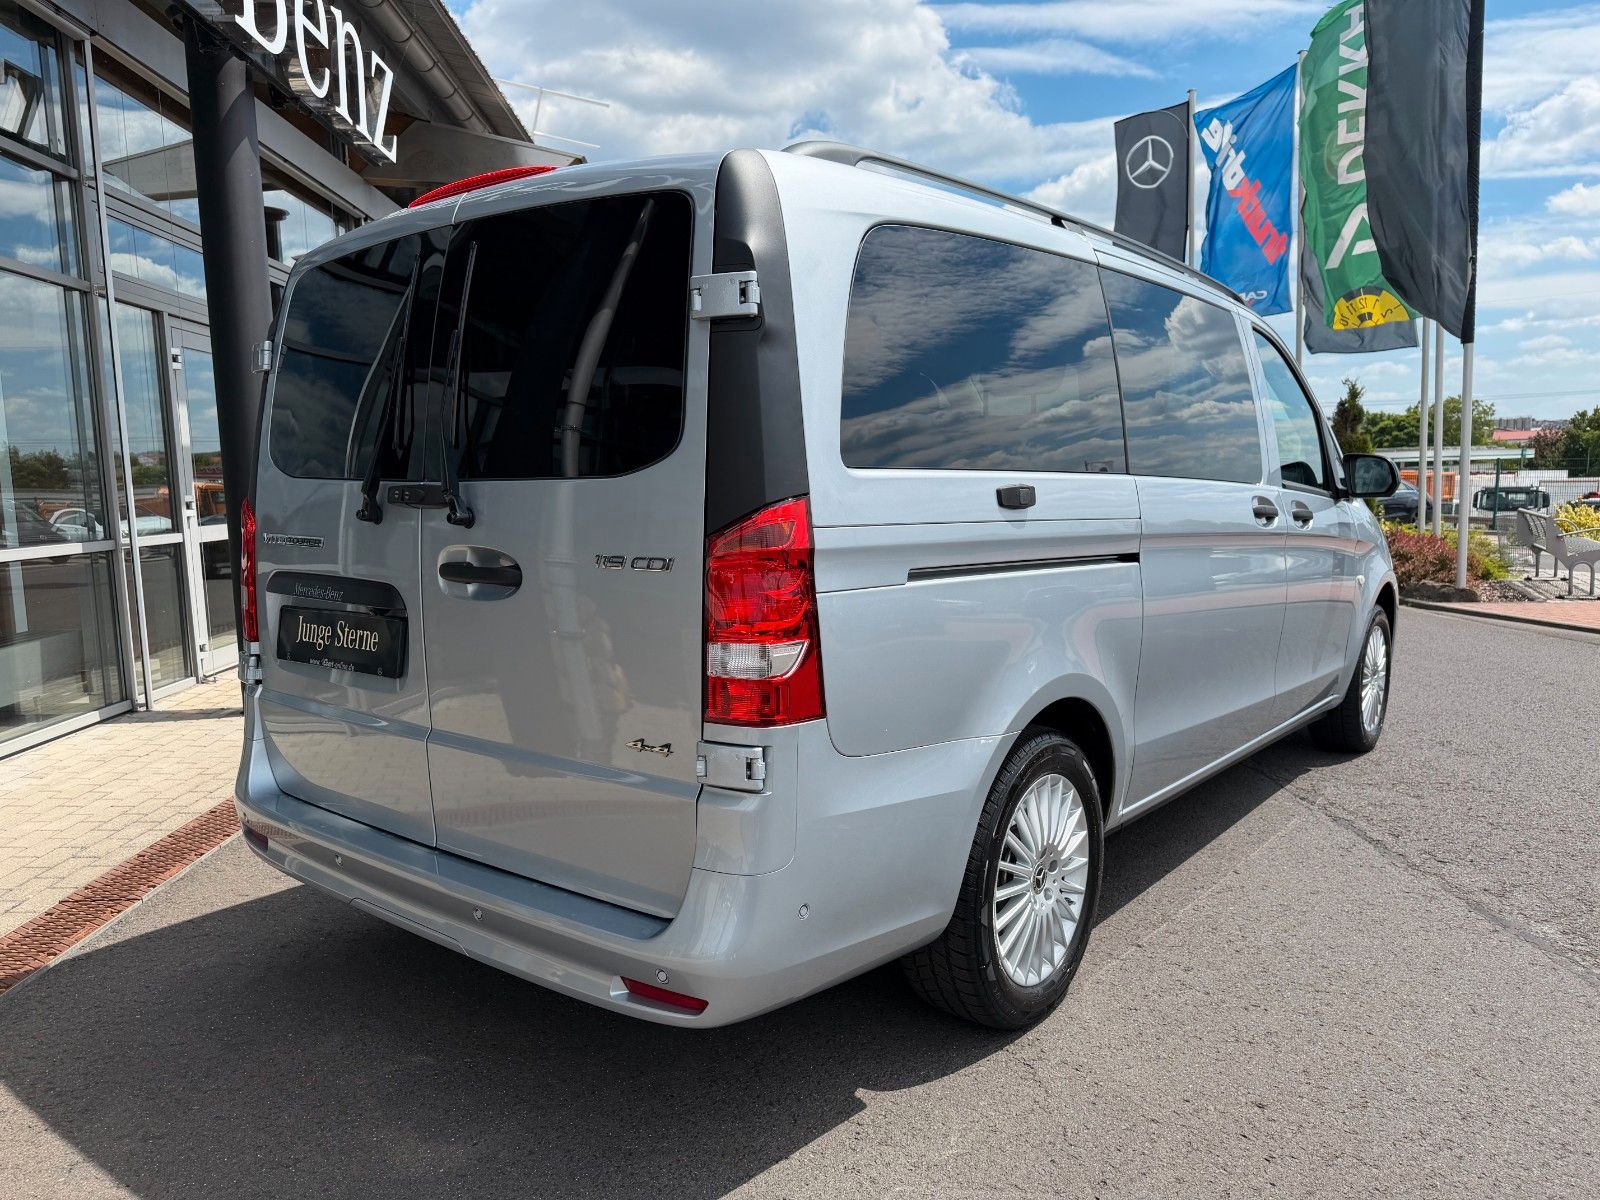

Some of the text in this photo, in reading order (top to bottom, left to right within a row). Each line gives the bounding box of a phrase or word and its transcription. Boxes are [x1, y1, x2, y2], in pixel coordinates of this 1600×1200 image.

[235, 0, 397, 164] enz
[631, 556, 675, 572] CDI
[293, 582, 344, 601] Mercedes-Benz
[296, 615, 379, 652] Junge Sterne
